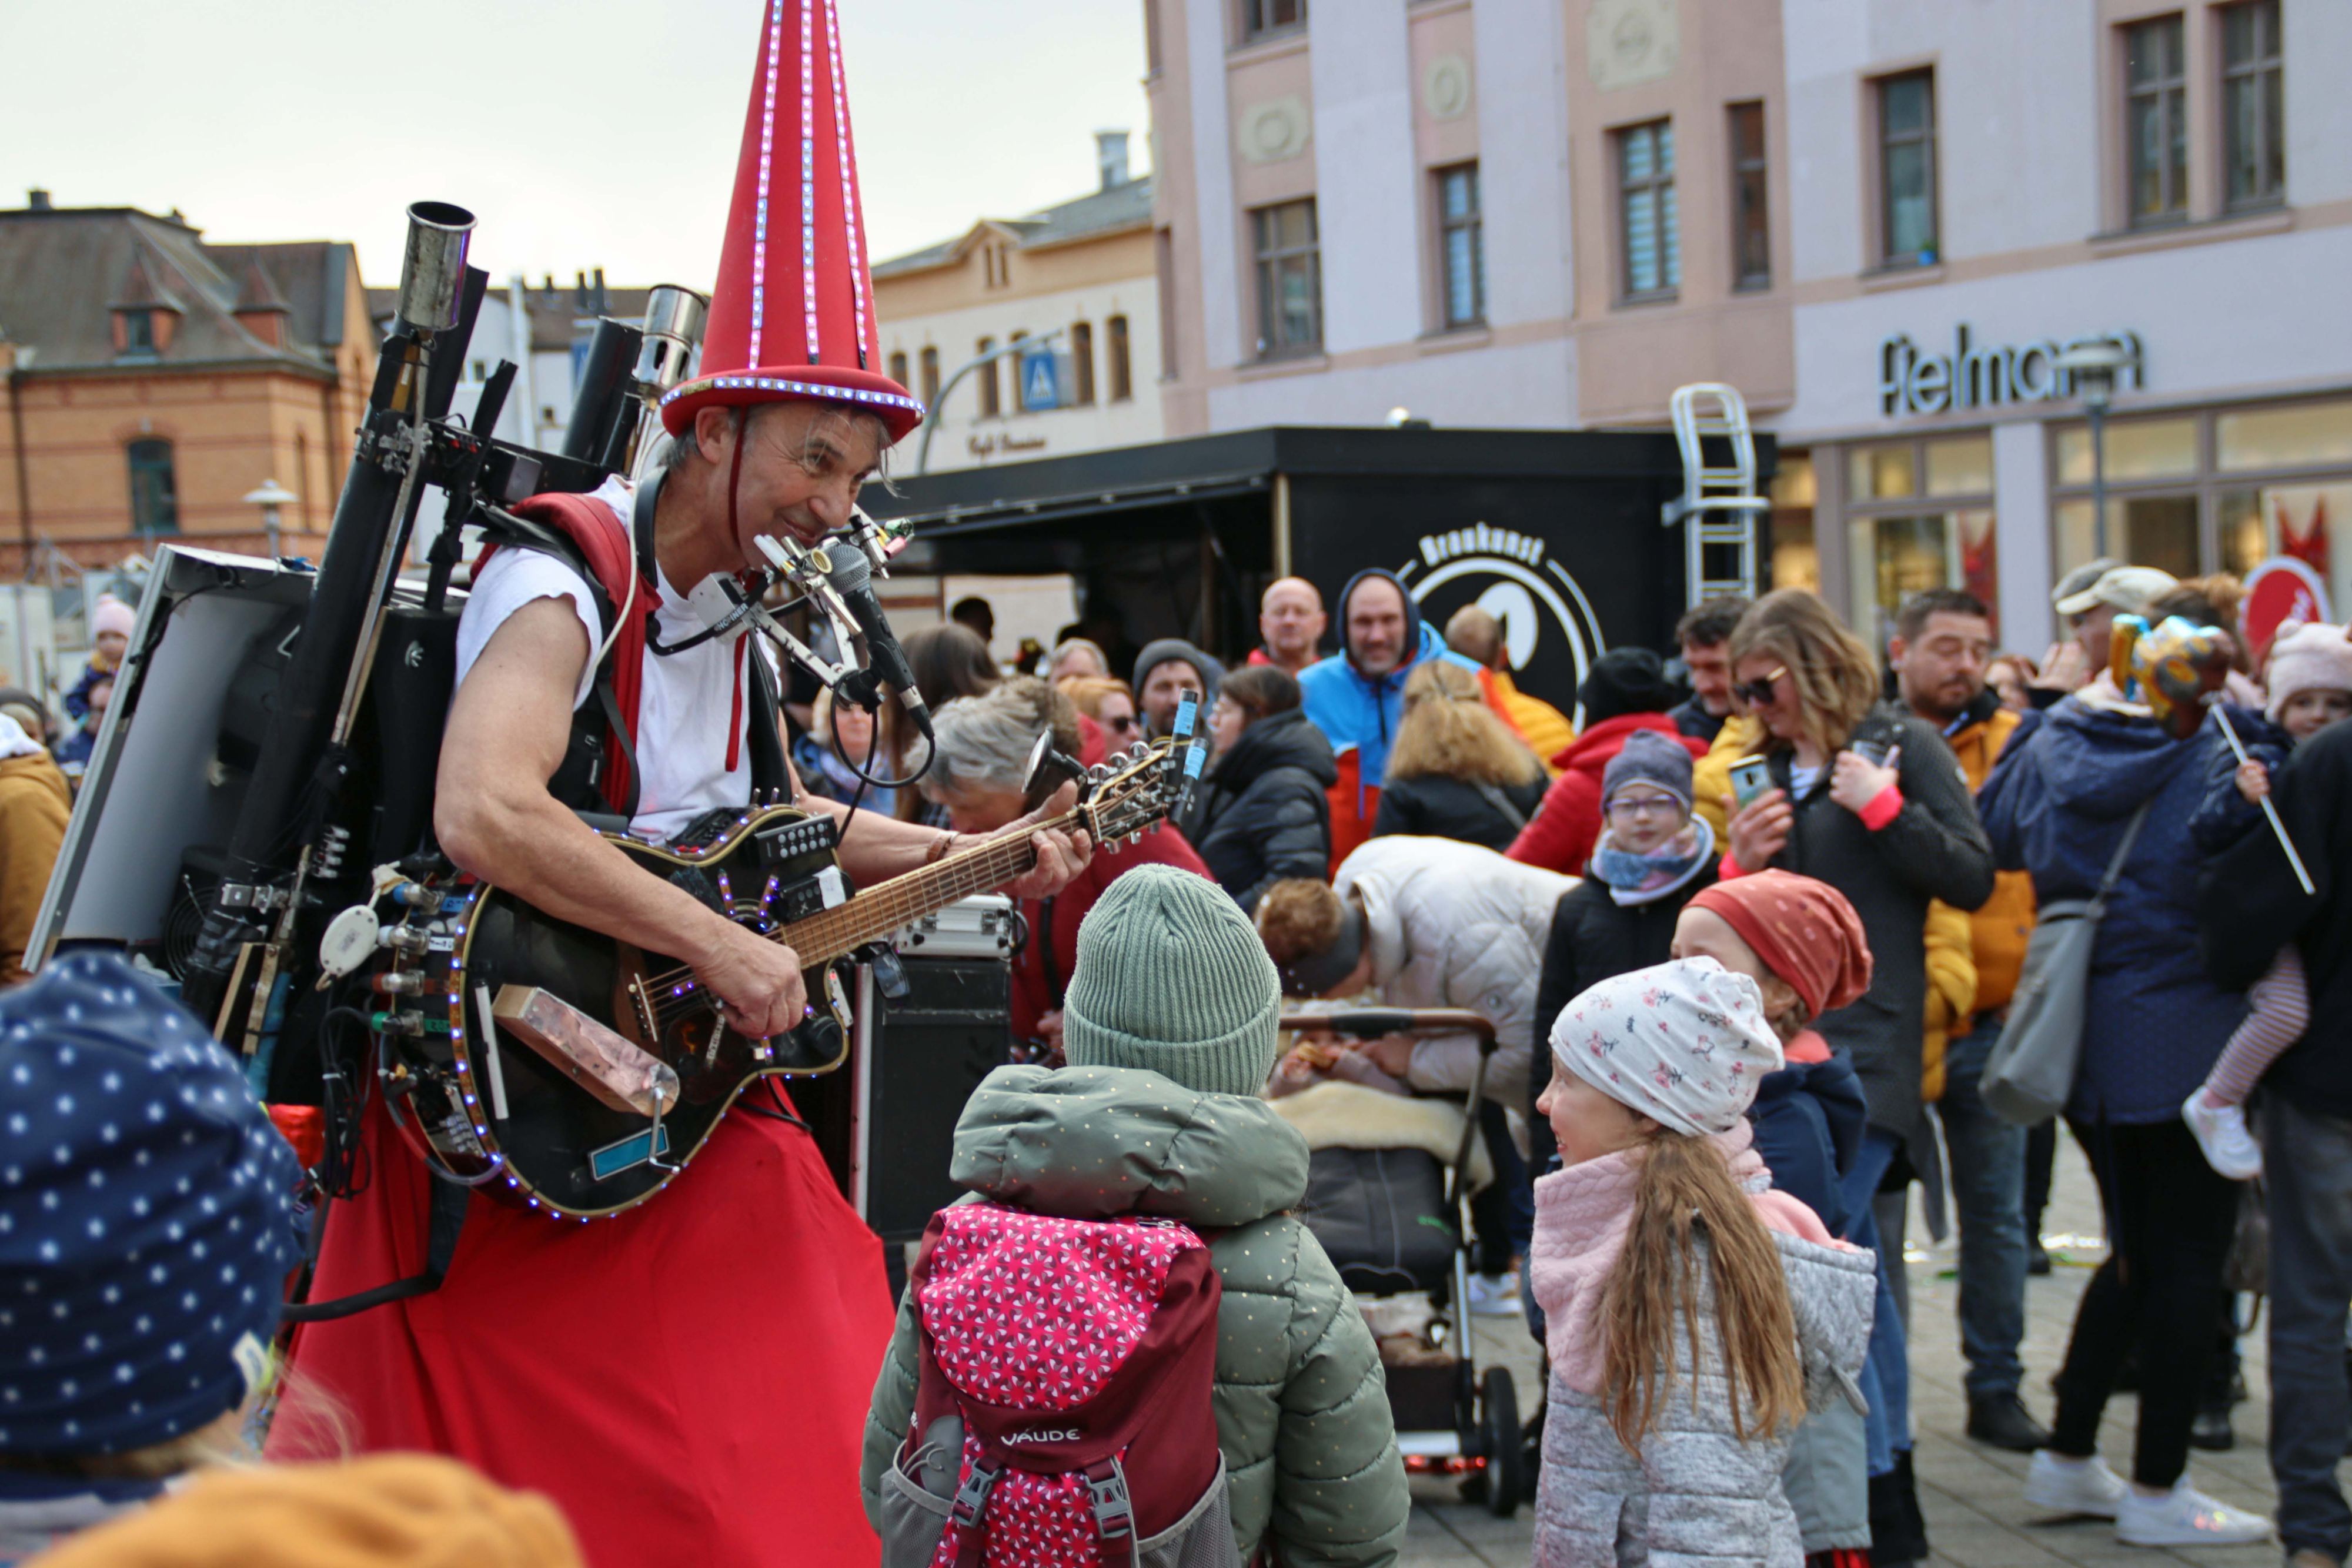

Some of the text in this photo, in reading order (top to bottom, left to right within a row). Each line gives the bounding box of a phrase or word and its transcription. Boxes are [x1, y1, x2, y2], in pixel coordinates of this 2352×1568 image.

[1418, 520, 1545, 567] Braukunst
[717, 602, 749, 631] HONER
[1000, 1427, 1081, 1446] VAUDE
